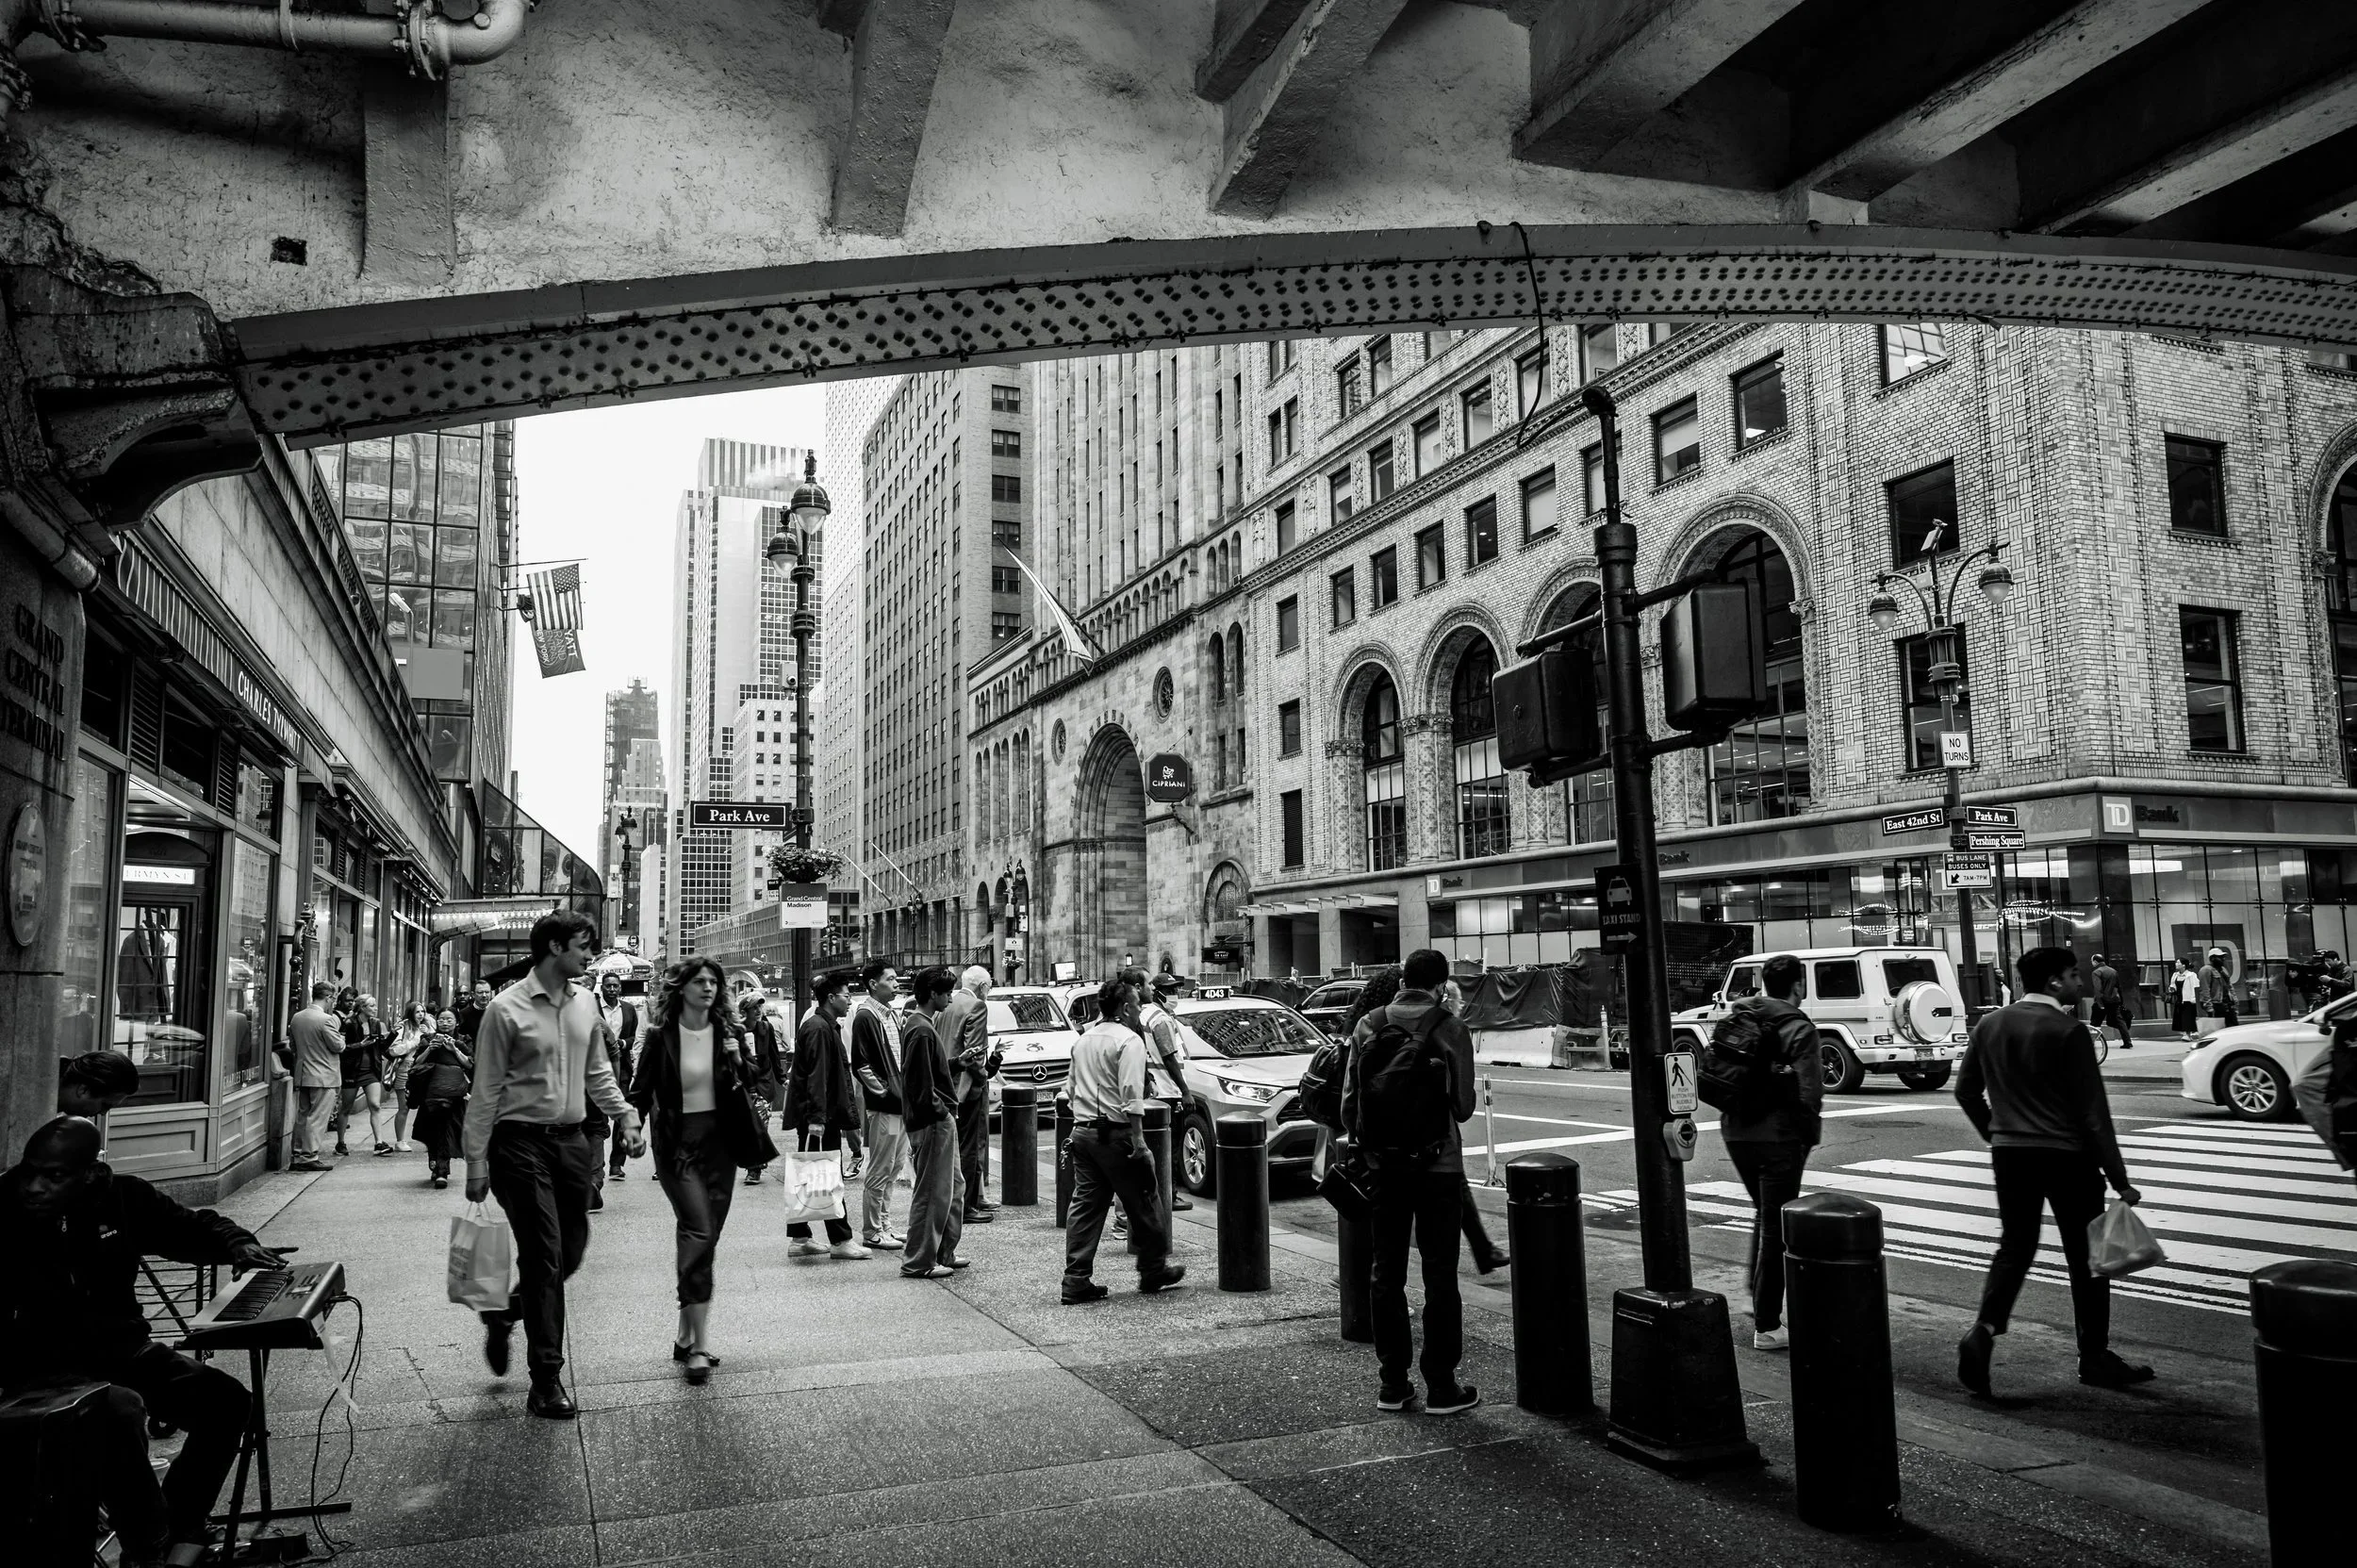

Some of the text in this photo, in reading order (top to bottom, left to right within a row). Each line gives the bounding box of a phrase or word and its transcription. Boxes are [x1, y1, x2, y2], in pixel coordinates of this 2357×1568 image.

[15, 604, 64, 667] GRAND
[565, 629, 578, 659] YATT
[6, 648, 65, 716] CENTRAL
[238, 670, 272, 724] CHARLES
[1949, 738, 1961, 748] NO
[1944, 751, 1969, 762] TURNS
[709, 809, 770, 822] Park Ave
[1975, 811, 2008, 822] Park Ave
[2105, 802, 2180, 827] TD Bank
[1886, 813, 1940, 831] East 42nd St
[1970, 835, 2023, 848] Pershing Square
[1602, 913, 1641, 925] TAXI STAND
[1205, 989, 1225, 999] 4D43
